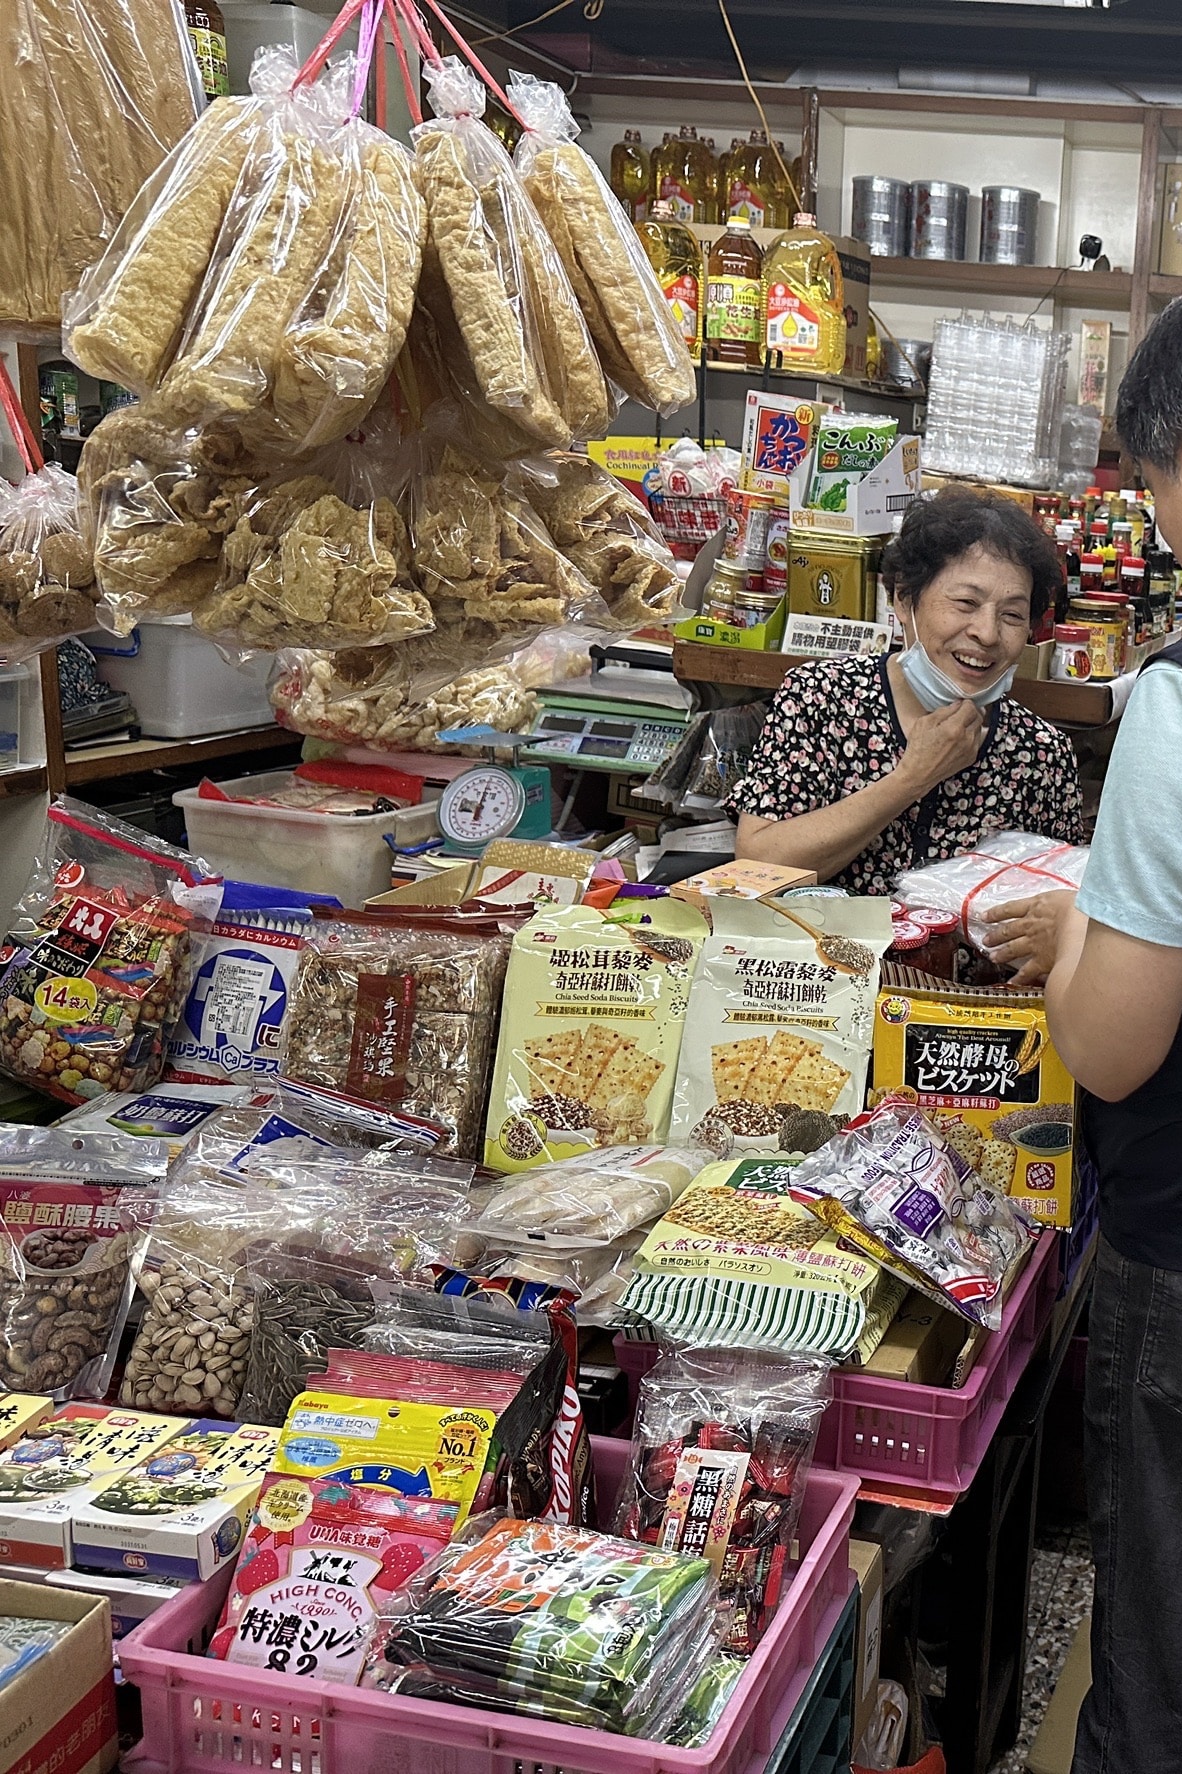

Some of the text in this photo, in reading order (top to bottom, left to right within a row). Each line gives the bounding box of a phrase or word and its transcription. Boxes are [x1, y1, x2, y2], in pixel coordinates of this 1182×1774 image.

[798, 409, 811, 421] 新
[823, 430, 885, 452] こんぶ
[606, 462, 650, 470] Cochineal
[671, 475, 687, 493] 新
[820, 622, 875, 640] 不主動提供
[791, 632, 862, 653] 購物用塑膠袋
[213, 926, 297, 947] 日カラダにカルシウム
[550, 949, 655, 971] 姬松茸藜麥
[735, 957, 838, 983] 黑松露藜麥
[555, 971, 642, 993] 奇亞籽蘇打餅乾
[743, 979, 828, 1004] 奇亞籽蘇打餅乾
[43, 985, 91, 1010] 14袋入
[572, 993, 590, 1001] Seed
[609, 995, 639, 1003] Biscuits
[742, 1000, 759, 1008] Chia
[760, 1002, 777, 1010] Seed
[258, 1024, 281, 1048] に
[375, 996, 399, 1077] 手工堅果
[225, 1051, 239, 1066] Ca
[241, 1054, 281, 1075] プラス
[914, 1040, 1020, 1073] 天然酵母の
[743, 1165, 796, 1178] 天然
[4, 1202, 121, 1231] 鹽酥腰果
[654, 1237, 868, 1280] 天然の紫菜風味 薄鹽蘇打餅
[660, 1257, 711, 1267] 自然のおいしさ
[298, 1399, 329, 1410] Kabaya
[438, 1437, 477, 1458] No.1
[544, 1385, 581, 1525] KOPIKO
[350, 1468, 392, 1482] 塩分
[270, 1489, 307, 1502] 北海道産
[309, 1525, 383, 1549] UHA味覚糖
[269, 1585, 363, 1623] HIGH CONC.
[240, 1607, 360, 1660] 特濃ミルク
